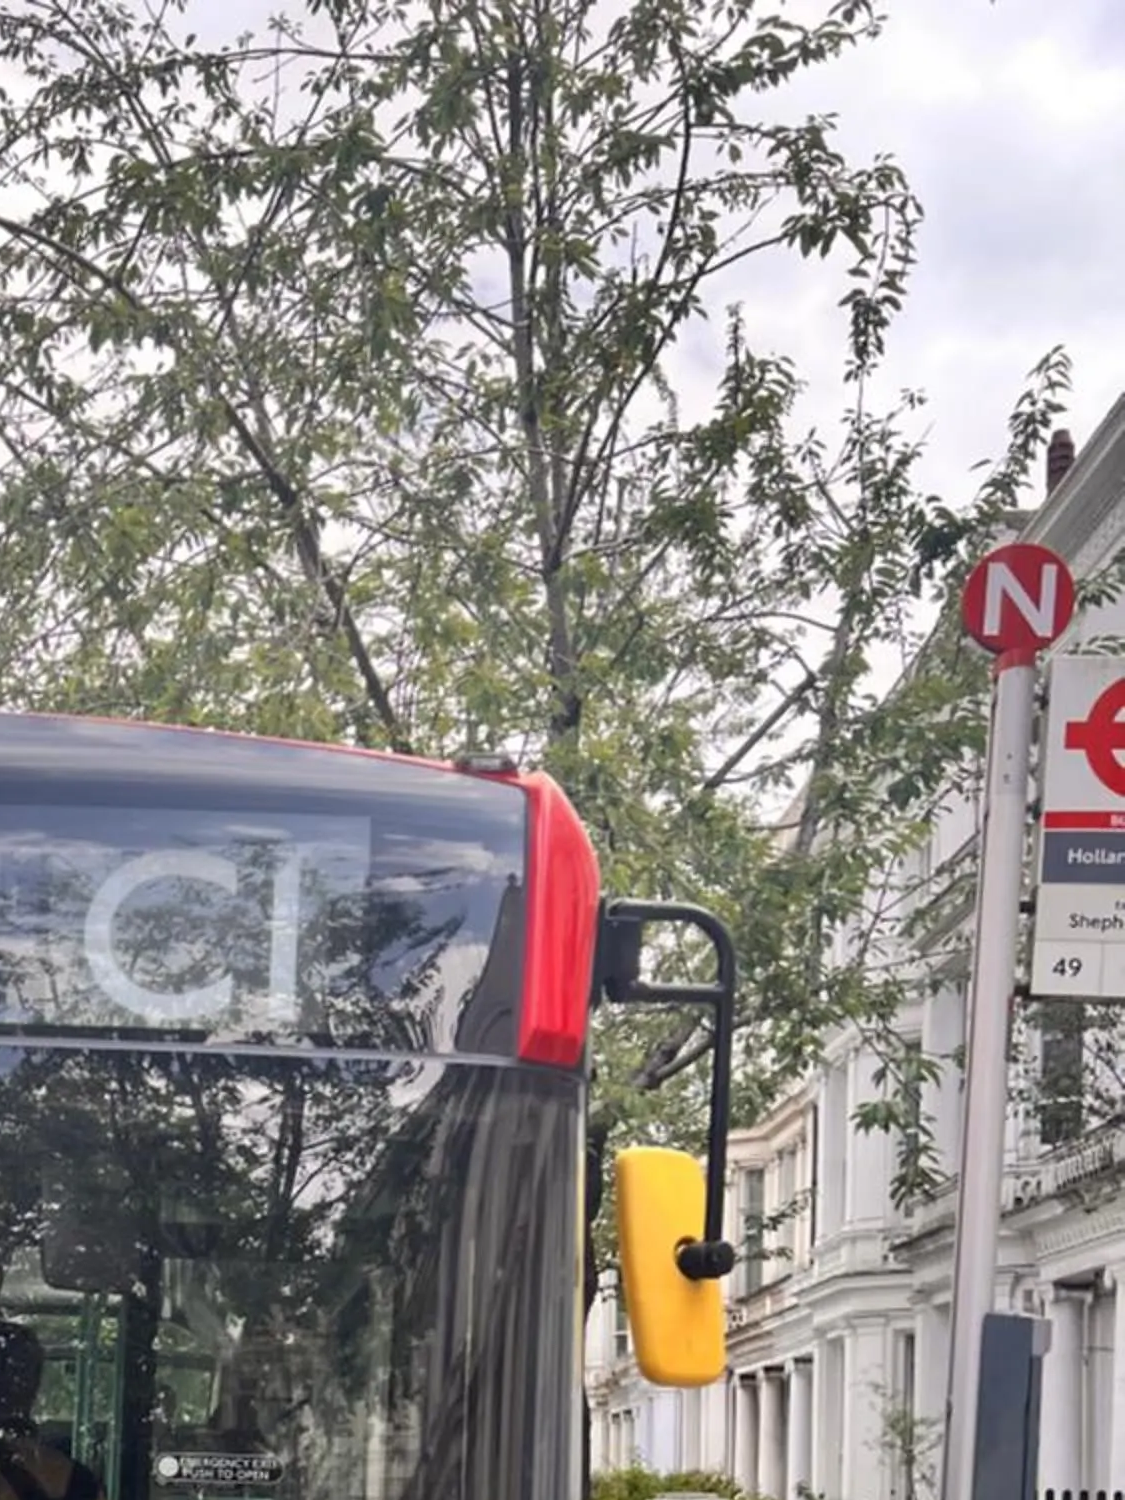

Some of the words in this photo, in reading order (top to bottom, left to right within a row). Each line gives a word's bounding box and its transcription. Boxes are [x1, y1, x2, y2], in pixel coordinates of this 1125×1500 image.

[983, 562, 1058, 638] N
[83, 847, 300, 1024] C1
[1053, 957, 1082, 977] 49
[217, 1469, 234, 1480] TO
[236, 1470, 270, 1481] OPEN
